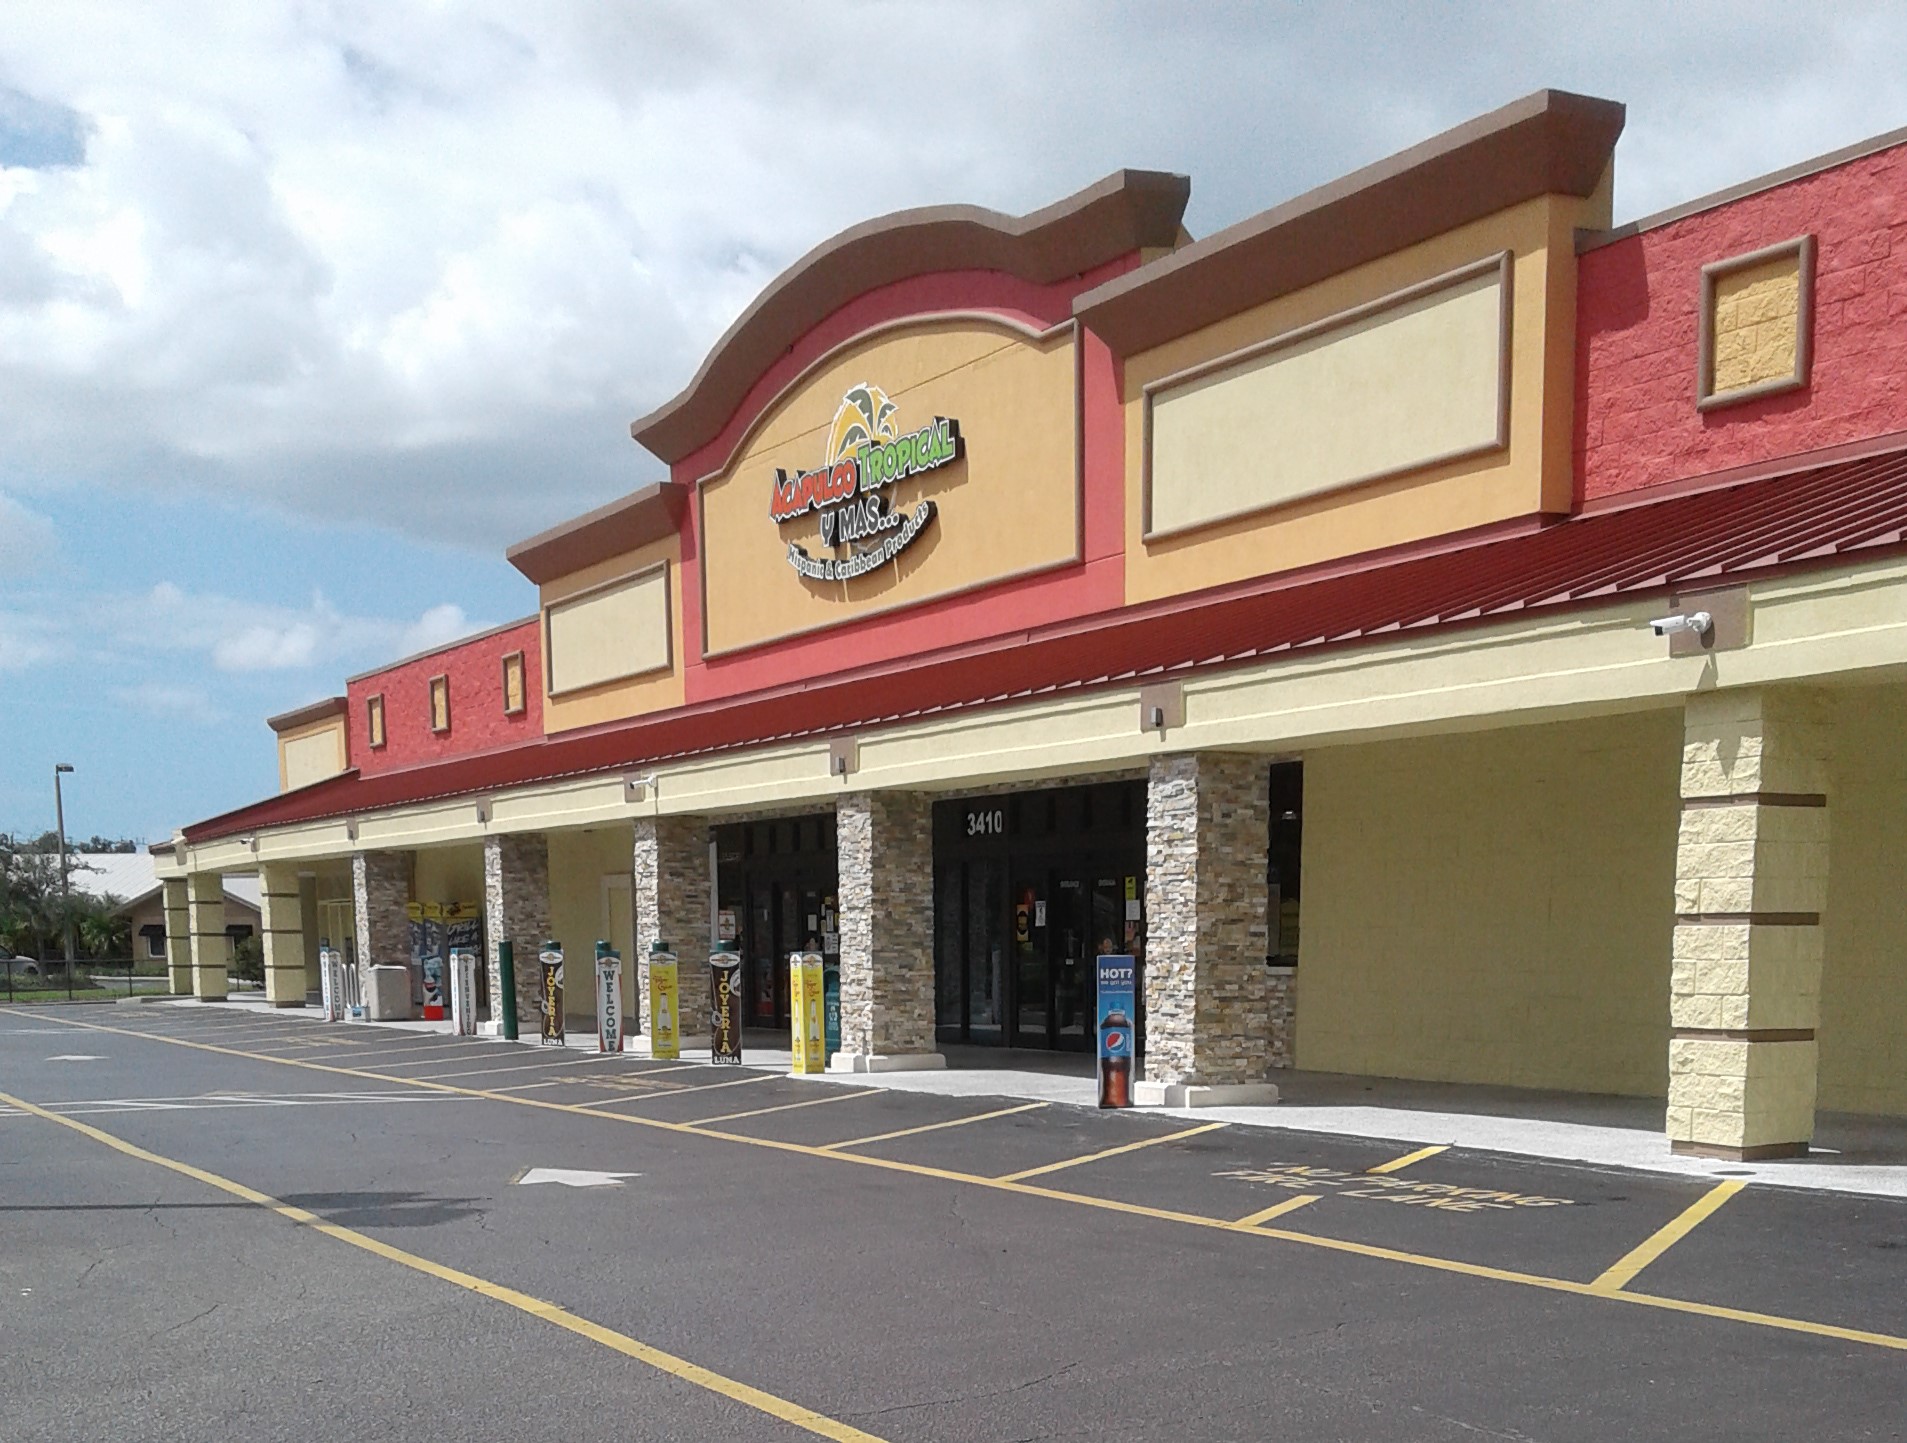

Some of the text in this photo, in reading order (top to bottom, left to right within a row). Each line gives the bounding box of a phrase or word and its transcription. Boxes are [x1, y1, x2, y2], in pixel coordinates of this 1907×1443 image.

[770, 419, 955, 522] ACAPULCO TROPICAL
[787, 501, 929, 580] Hispanic & Caribbean Products
[821, 512, 834, 546] Y
[967, 810, 1003, 835] 3410
[1100, 968, 1133, 979] HOT?
[547, 966, 556, 1036] JOYERIA
[603, 970, 617, 1051] WELCOME
[719, 970, 731, 1053] JOYERIA
[543, 1038, 563, 1046] LUNA
[714, 1056, 740, 1064] LUNA
[1266, 1166, 1575, 1206] NO PARKING
[1337, 1189, 1513, 1212] LANE
